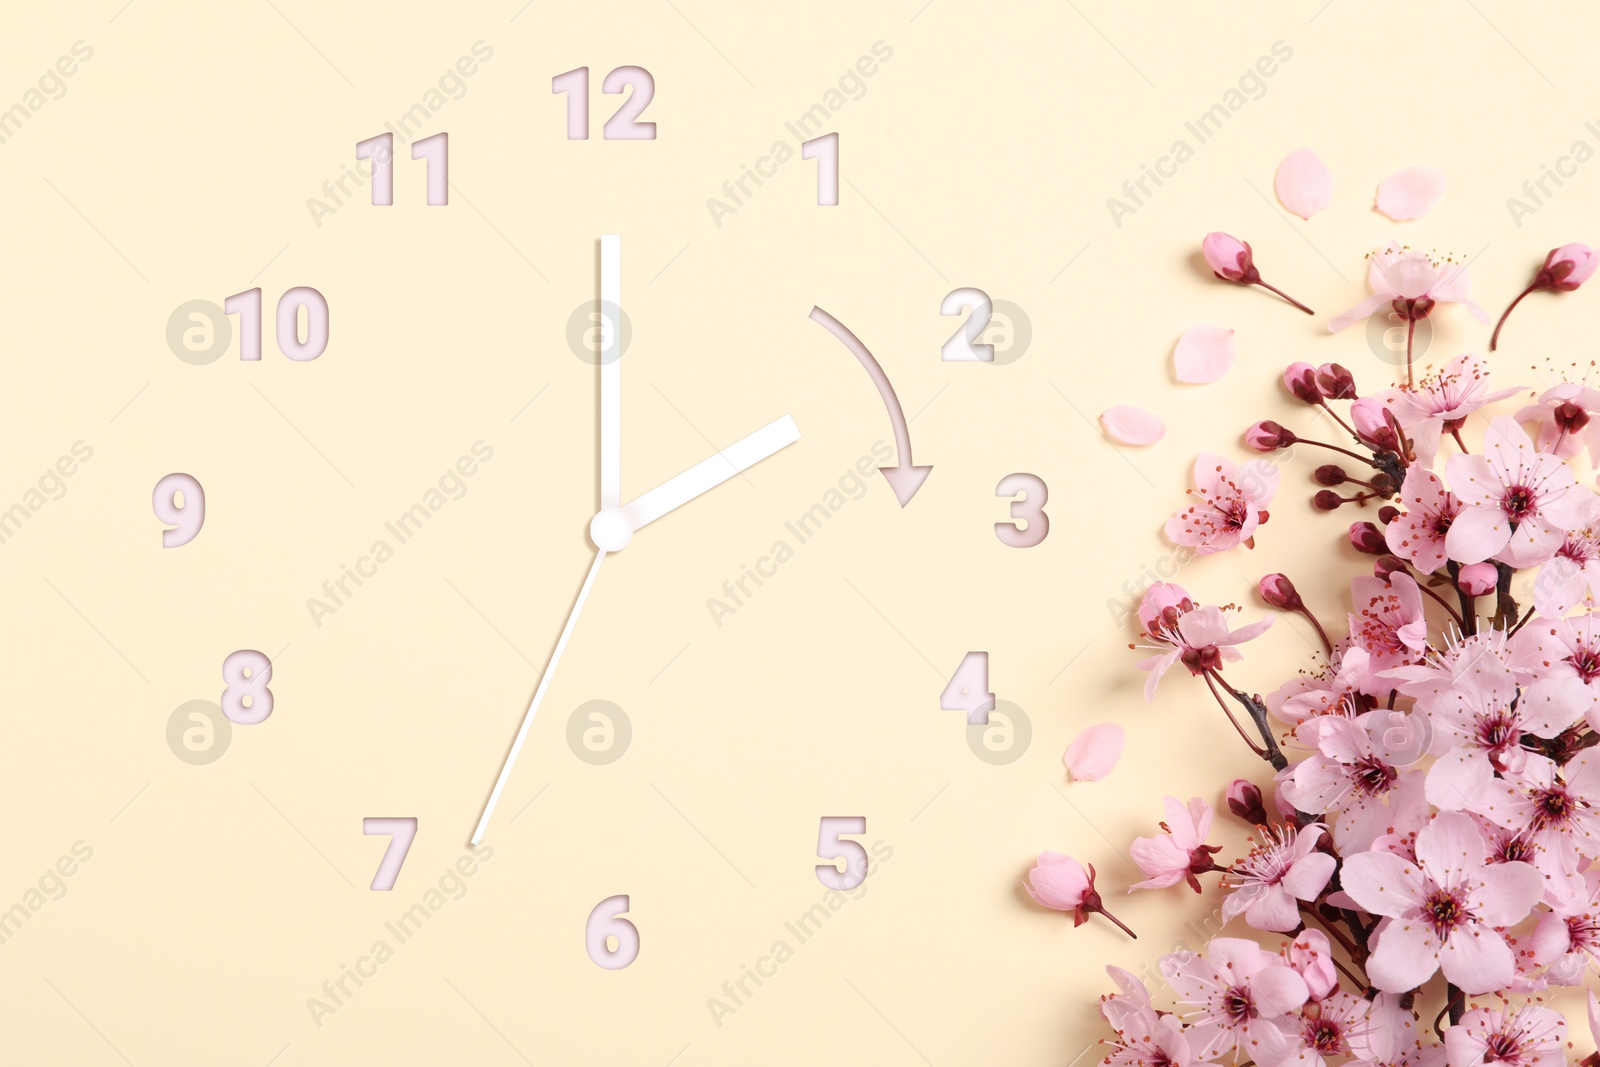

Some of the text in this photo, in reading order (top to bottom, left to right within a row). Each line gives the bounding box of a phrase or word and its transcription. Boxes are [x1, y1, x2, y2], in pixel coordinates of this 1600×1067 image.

[552, 66, 657, 141] 12
[356, 132, 449, 207] 11
[802, 132, 839, 207] 1
[224, 287, 329, 363] 10
[940, 288, 995, 363] 2
[152, 473, 206, 548] 9
[995, 474, 1050, 549] 3
[221, 650, 274, 725] 8
[940, 651, 996, 726] 4
[363, 817, 418, 892] 7
[815, 816, 868, 891] 5
[585, 895, 641, 970] 6
